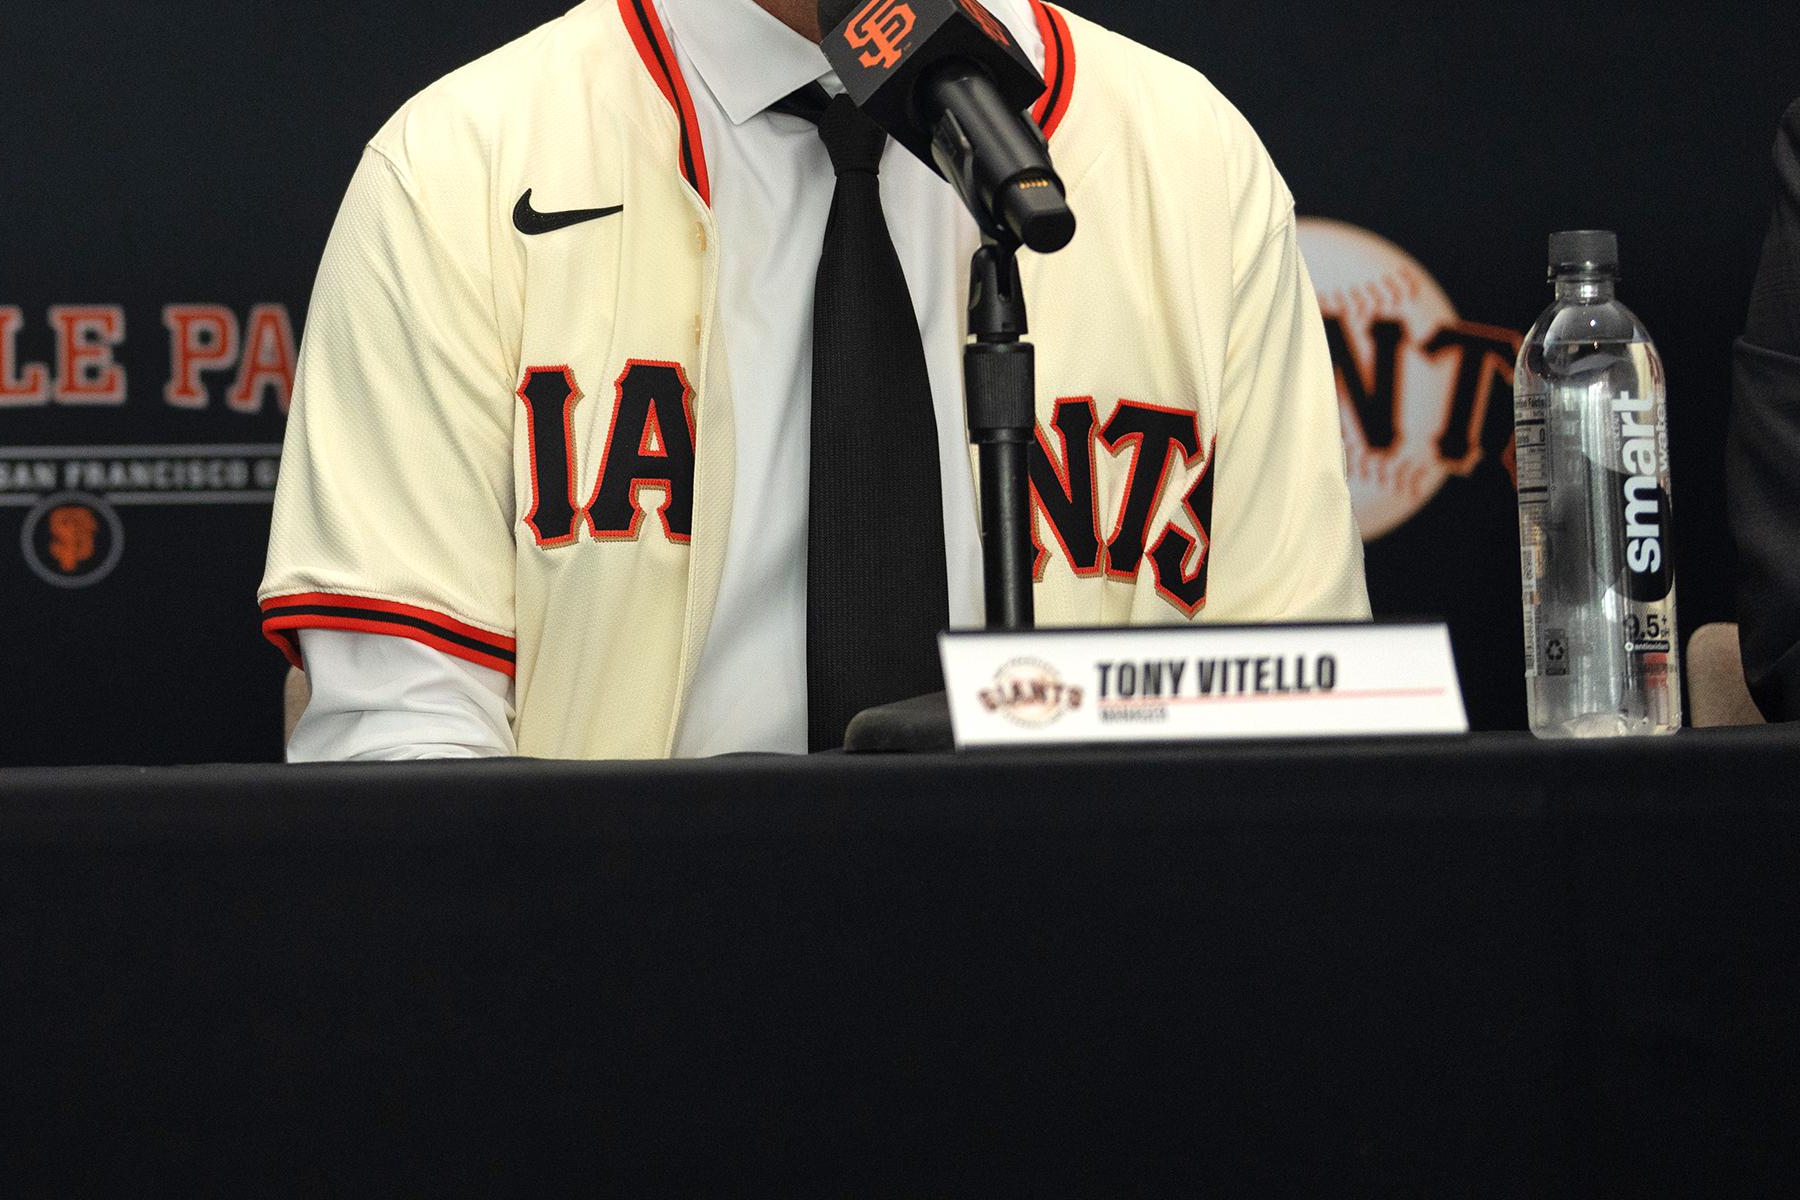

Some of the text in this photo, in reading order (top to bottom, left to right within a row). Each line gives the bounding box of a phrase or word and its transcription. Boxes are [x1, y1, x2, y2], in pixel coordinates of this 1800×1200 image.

[162, 303, 300, 415] PA
[1612, 390, 1661, 574] smart
[1095, 659, 1186, 698] TONY
[1198, 655, 1339, 695] VITELLO
